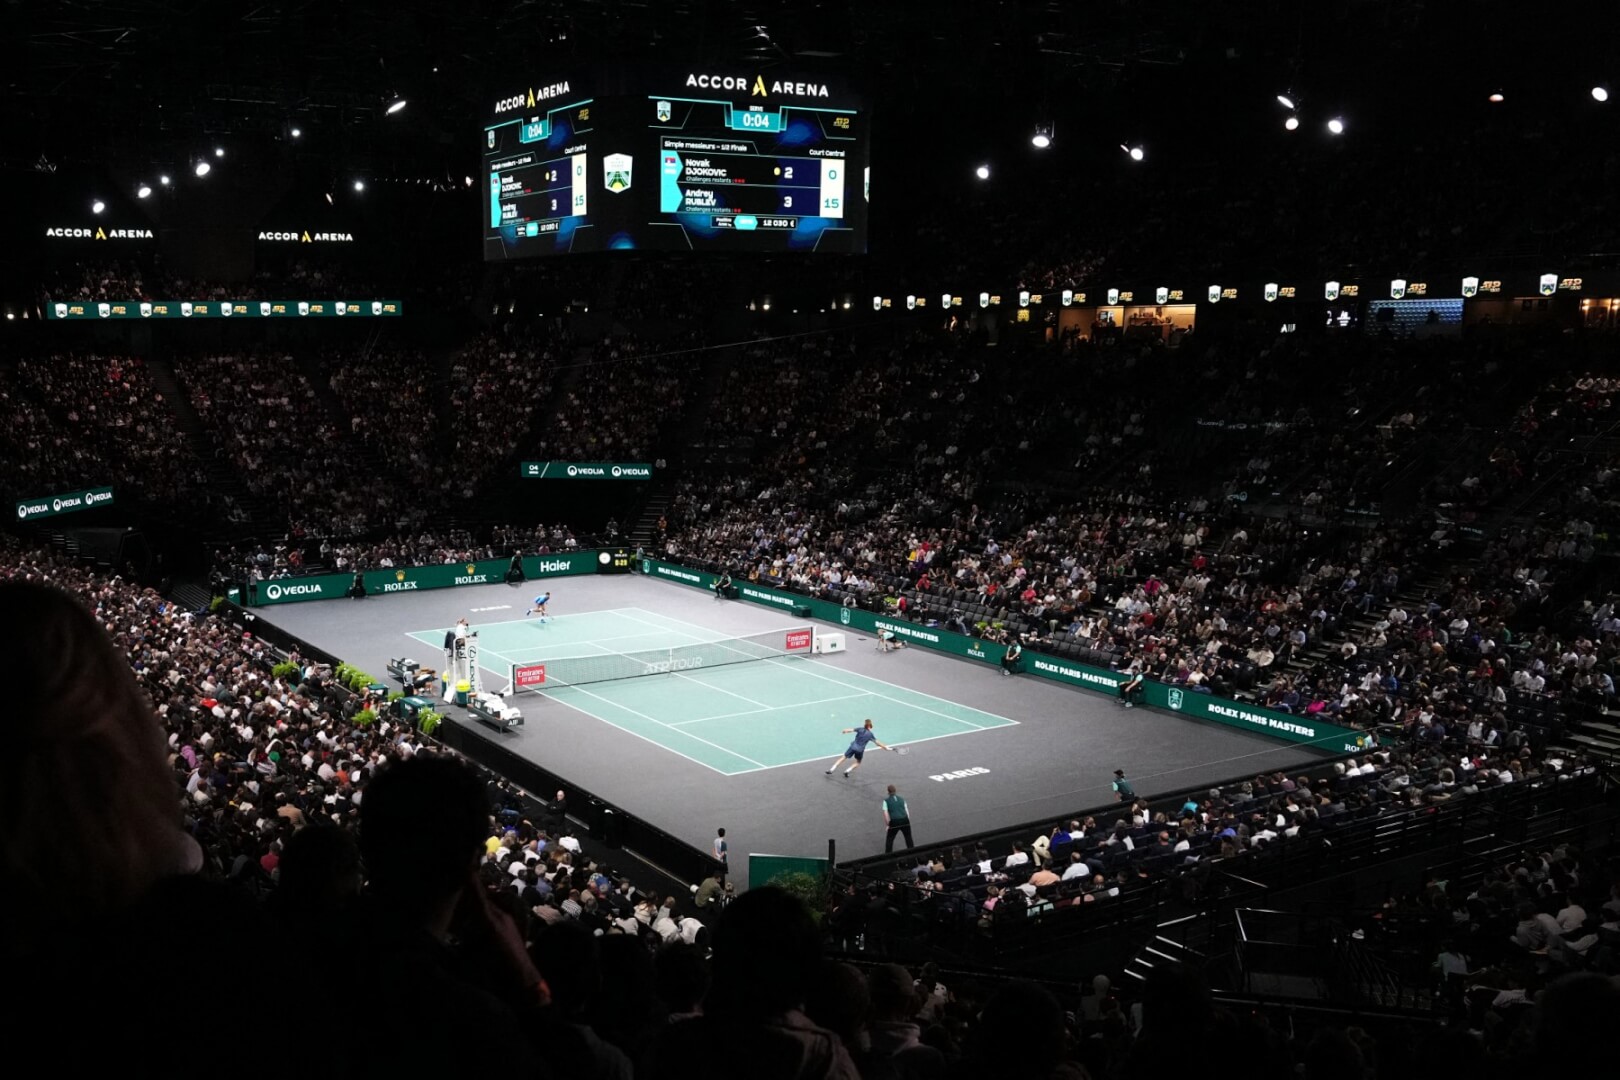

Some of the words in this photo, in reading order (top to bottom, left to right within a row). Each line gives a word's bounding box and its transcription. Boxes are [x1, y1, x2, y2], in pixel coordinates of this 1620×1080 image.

[686, 74, 747, 90] ACCOR
[772, 81, 829, 98] ARENA
[495, 94, 525, 114] ACCOR
[537, 81, 570, 101] ARENA
[742, 114, 770, 128] 0:04
[528, 124, 542, 138] 0:04
[685, 158, 710, 167] Novak
[551, 170, 557, 182] 2
[576, 166, 582, 176] 0
[685, 168, 727, 177] DJOKOVIC
[784, 167, 793, 178] 2
[828, 170, 837, 180] 0
[685, 189, 713, 200] Andrey
[551, 199, 557, 211] 3
[575, 195, 584, 206] 15
[685, 198, 716, 206] RUBLEV
[784, 196, 792, 207] 3
[824, 198, 839, 208] 15
[46, 228, 92, 238] ACCOR
[109, 229, 153, 239] ARENA
[258, 232, 298, 241] ACCOR
[314, 232, 353, 242] ARENA
[578, 467, 604, 475] VEOLIA
[622, 468, 649, 476] VEOLIA
[94, 492, 112, 501] VEOLIA
[61, 498, 81, 508] VEOLIA
[26, 504, 48, 514] VEOLIA
[540, 560, 570, 573] Haier
[454, 574, 487, 585] ROLEX
[282, 584, 322, 596] VEOLIA
[384, 581, 417, 592] ROLEX
[875, 621, 894, 631] ROLEX
[894, 626, 911, 635] PARIS
[911, 630, 939, 642] MASTERS
[968, 649, 985, 658] ROLEX
[672, 657, 703, 669] TOUR
[518, 669, 544, 677] Emirates
[1035, 661, 1058, 673] ROLEX
[1060, 667, 1081, 679] PARIS
[1082, 672, 1118, 688] MASTERS
[1208, 704, 1238, 718] ROLEX
[1240, 711, 1267, 725] PARIS
[1269, 718, 1315, 737] MASTERS
[928, 766, 990, 782] PARIS
